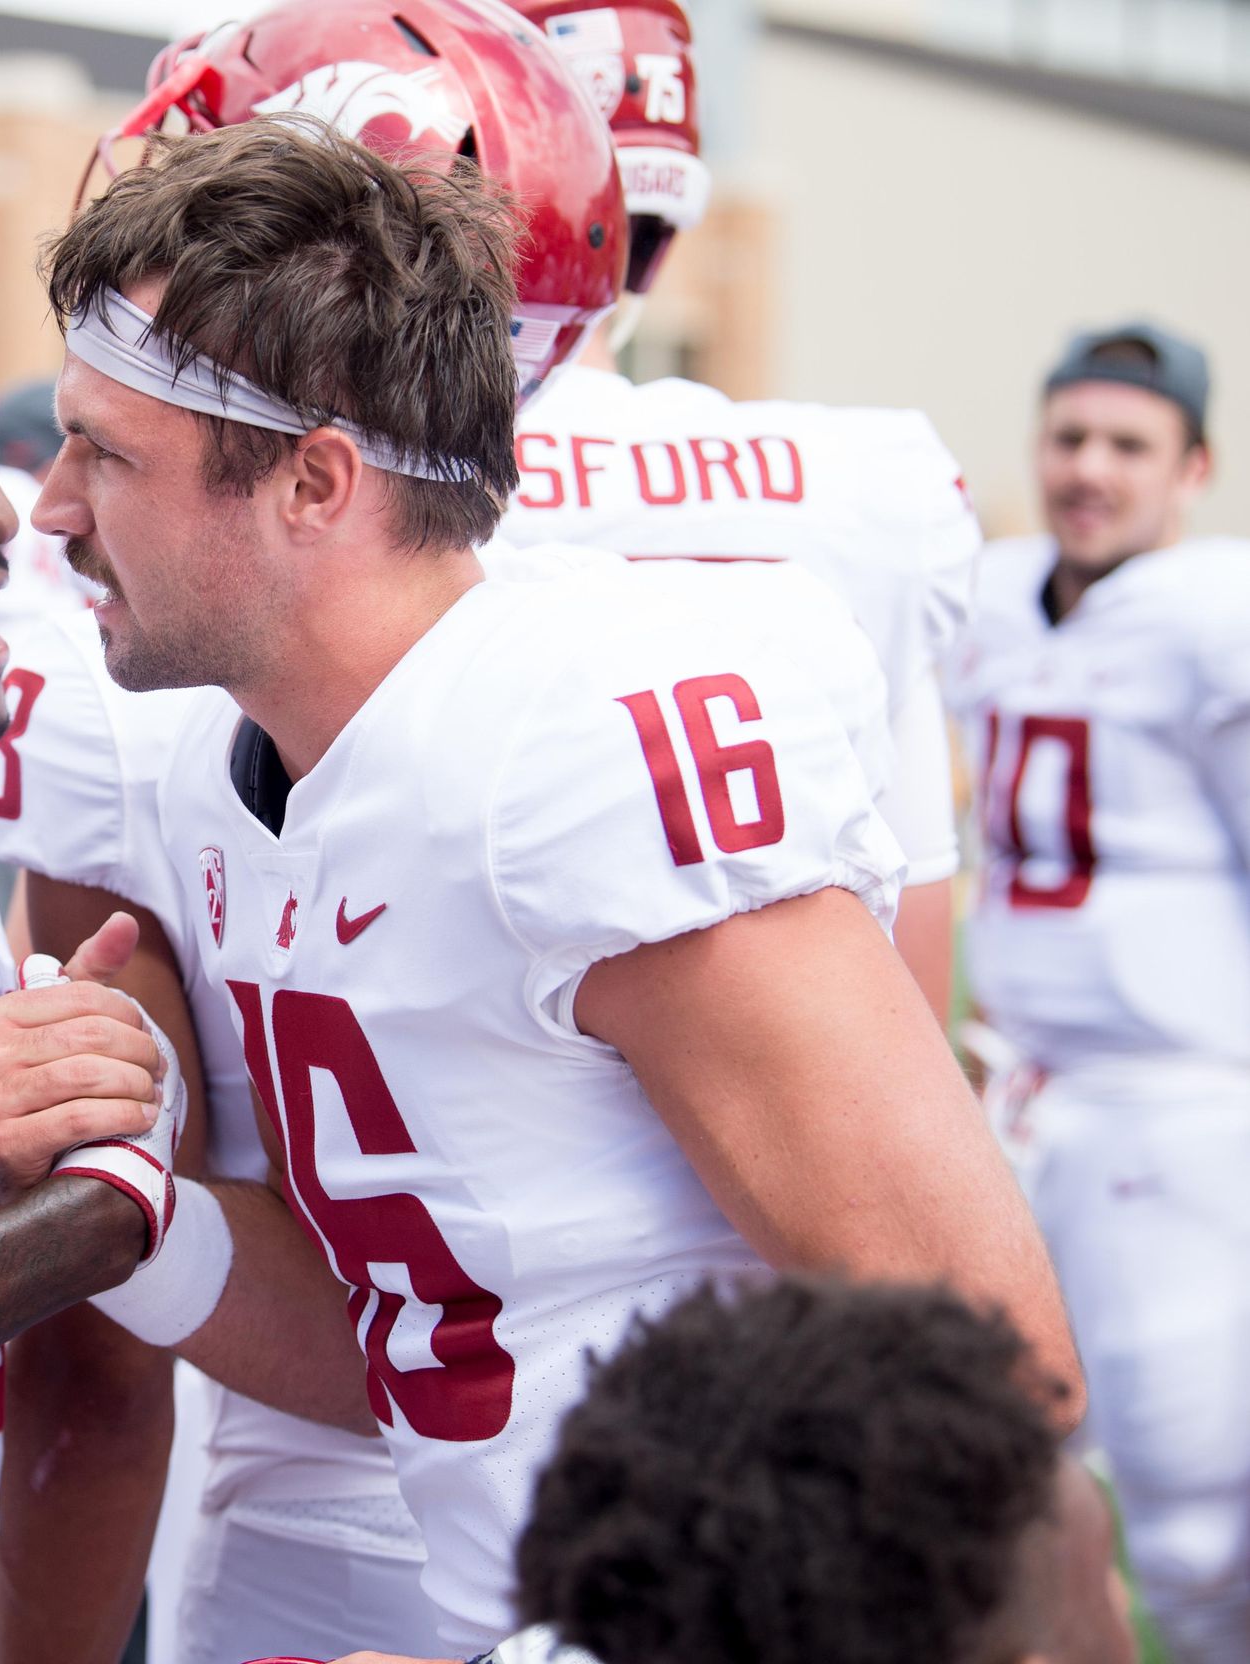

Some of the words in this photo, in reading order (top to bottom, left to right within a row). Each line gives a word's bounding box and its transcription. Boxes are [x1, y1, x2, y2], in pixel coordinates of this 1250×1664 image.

[634, 53, 686, 124] 75
[514, 434, 804, 509] SFORD
[612, 672, 786, 867] 16
[225, 979, 517, 1442] 16
